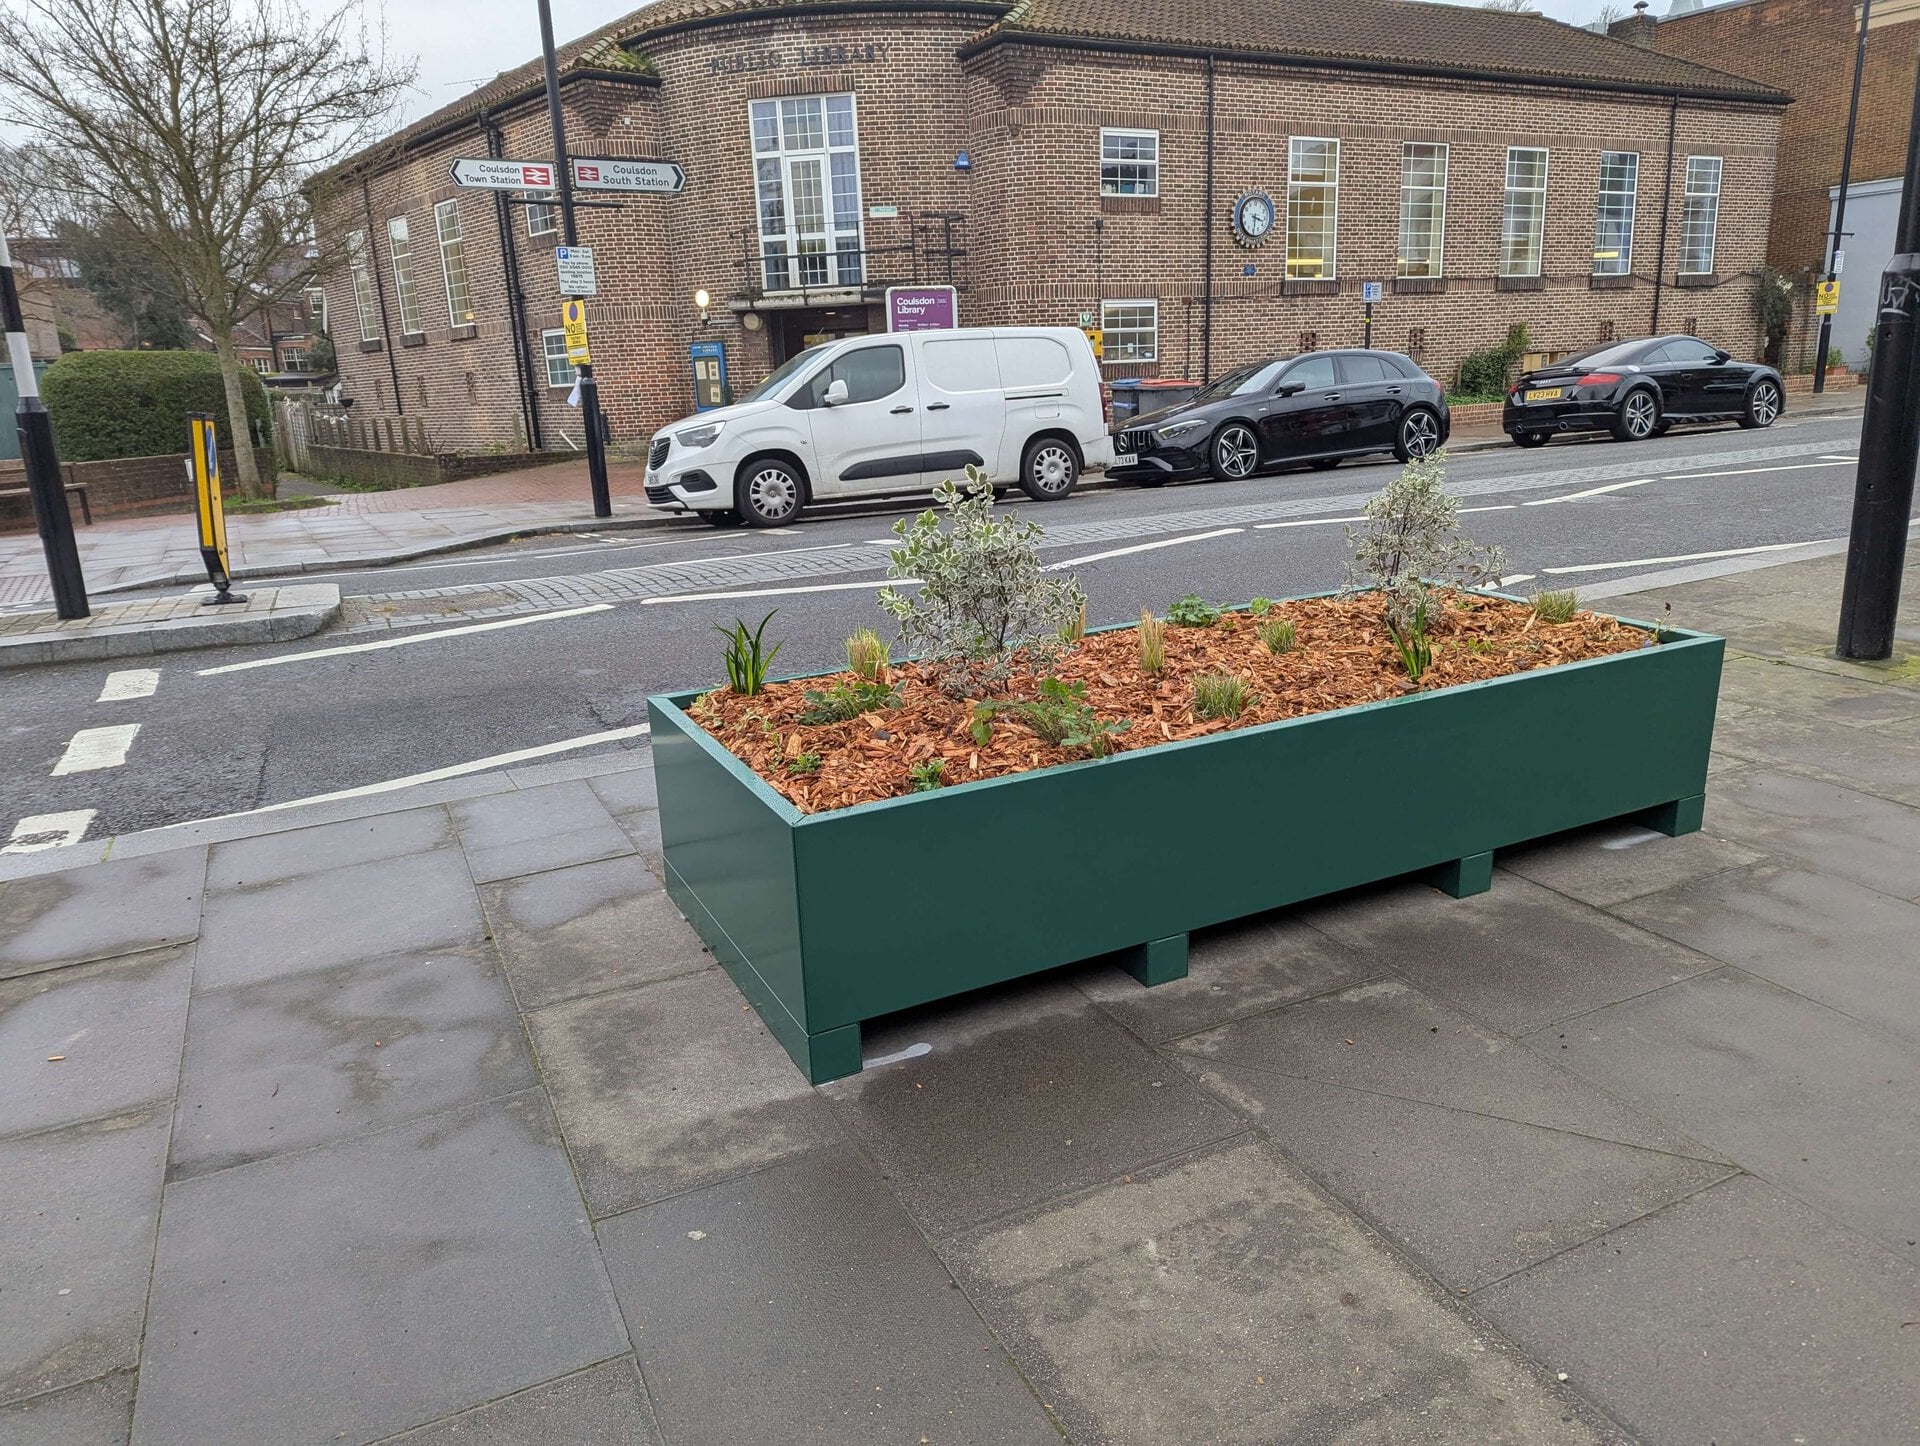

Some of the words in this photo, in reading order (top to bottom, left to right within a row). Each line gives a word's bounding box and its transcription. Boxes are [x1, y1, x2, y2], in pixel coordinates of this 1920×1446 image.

[711, 51, 782, 75] PUBLIC
[800, 44, 890, 66] LIBRARY
[479, 164, 520, 175] Coulsdon
[613, 165, 658, 176] Coulsdon
[464, 174, 488, 183] Town
[490, 175, 521, 185] Station
[602, 175, 631, 186] South
[634, 176, 670, 187] Station
[560, 249, 567, 258] P
[896, 297, 935, 306] Coulsdon
[897, 306, 926, 315] Library
[565, 323, 576, 334] NO
